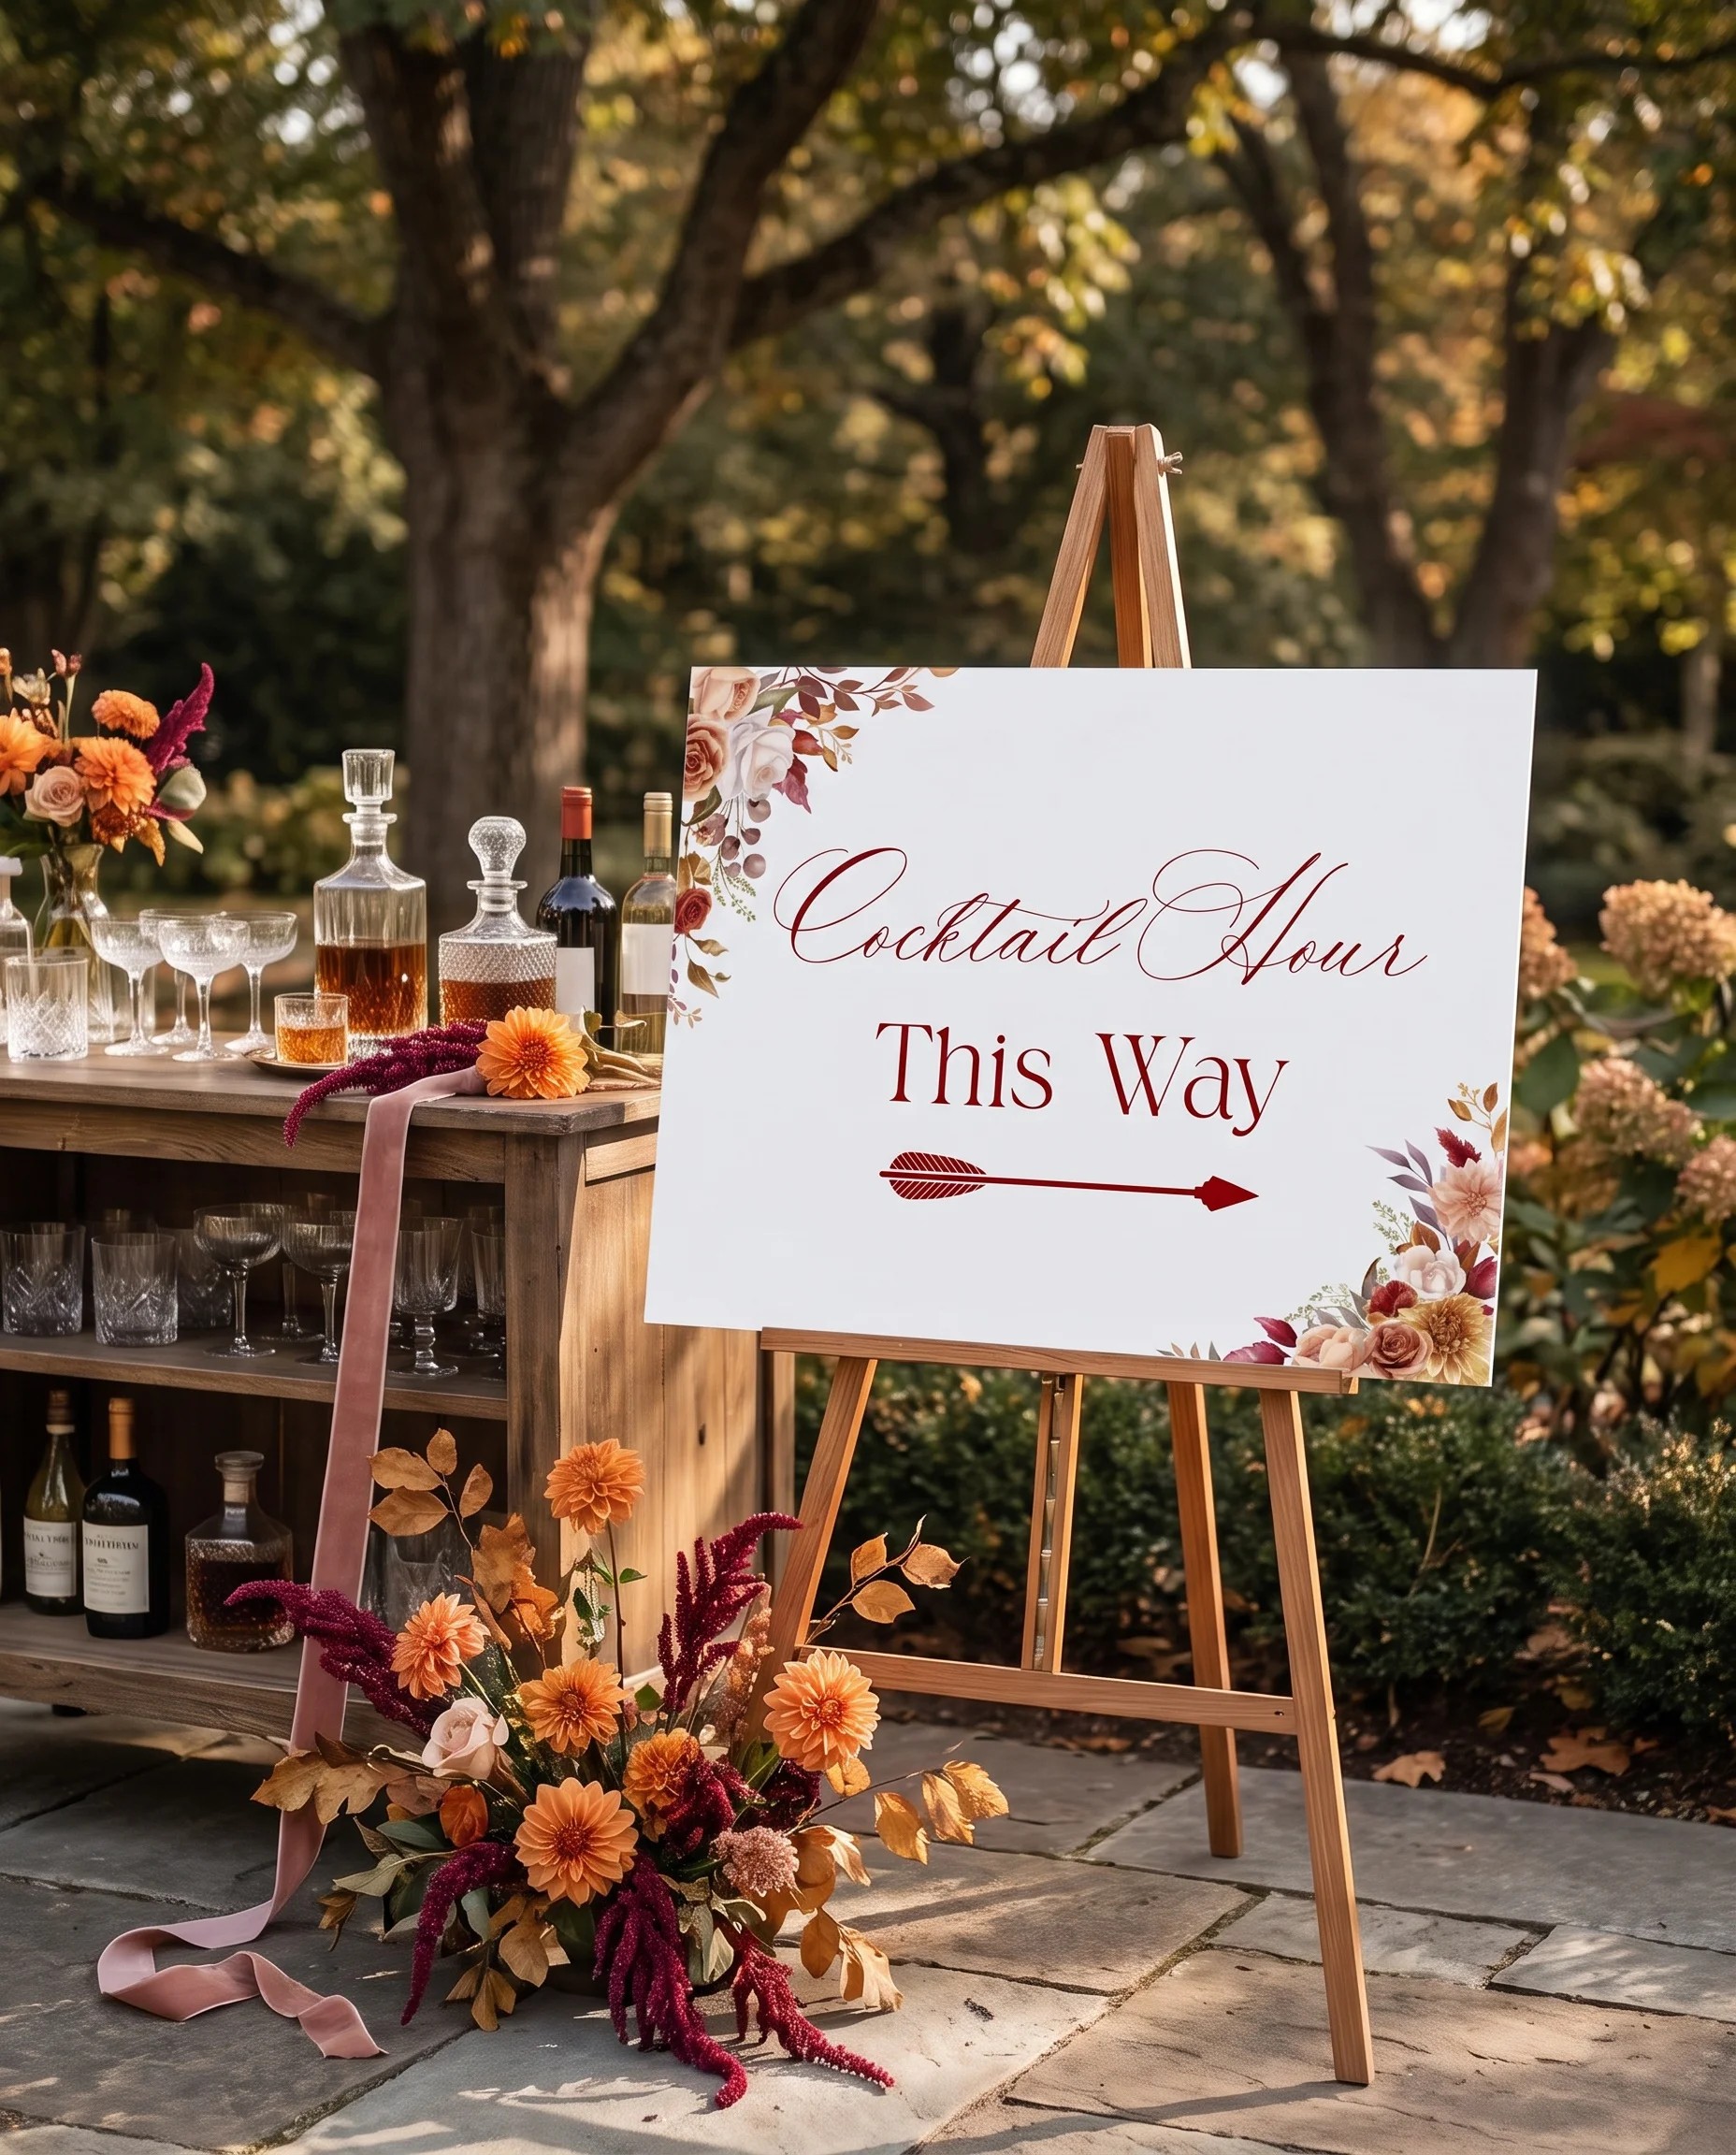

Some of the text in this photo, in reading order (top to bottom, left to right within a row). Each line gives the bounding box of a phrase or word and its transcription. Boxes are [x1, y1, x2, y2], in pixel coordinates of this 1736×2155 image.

[773, 846, 1428, 986] Cocktail Hour
[875, 1021, 1290, 1138] This Way
